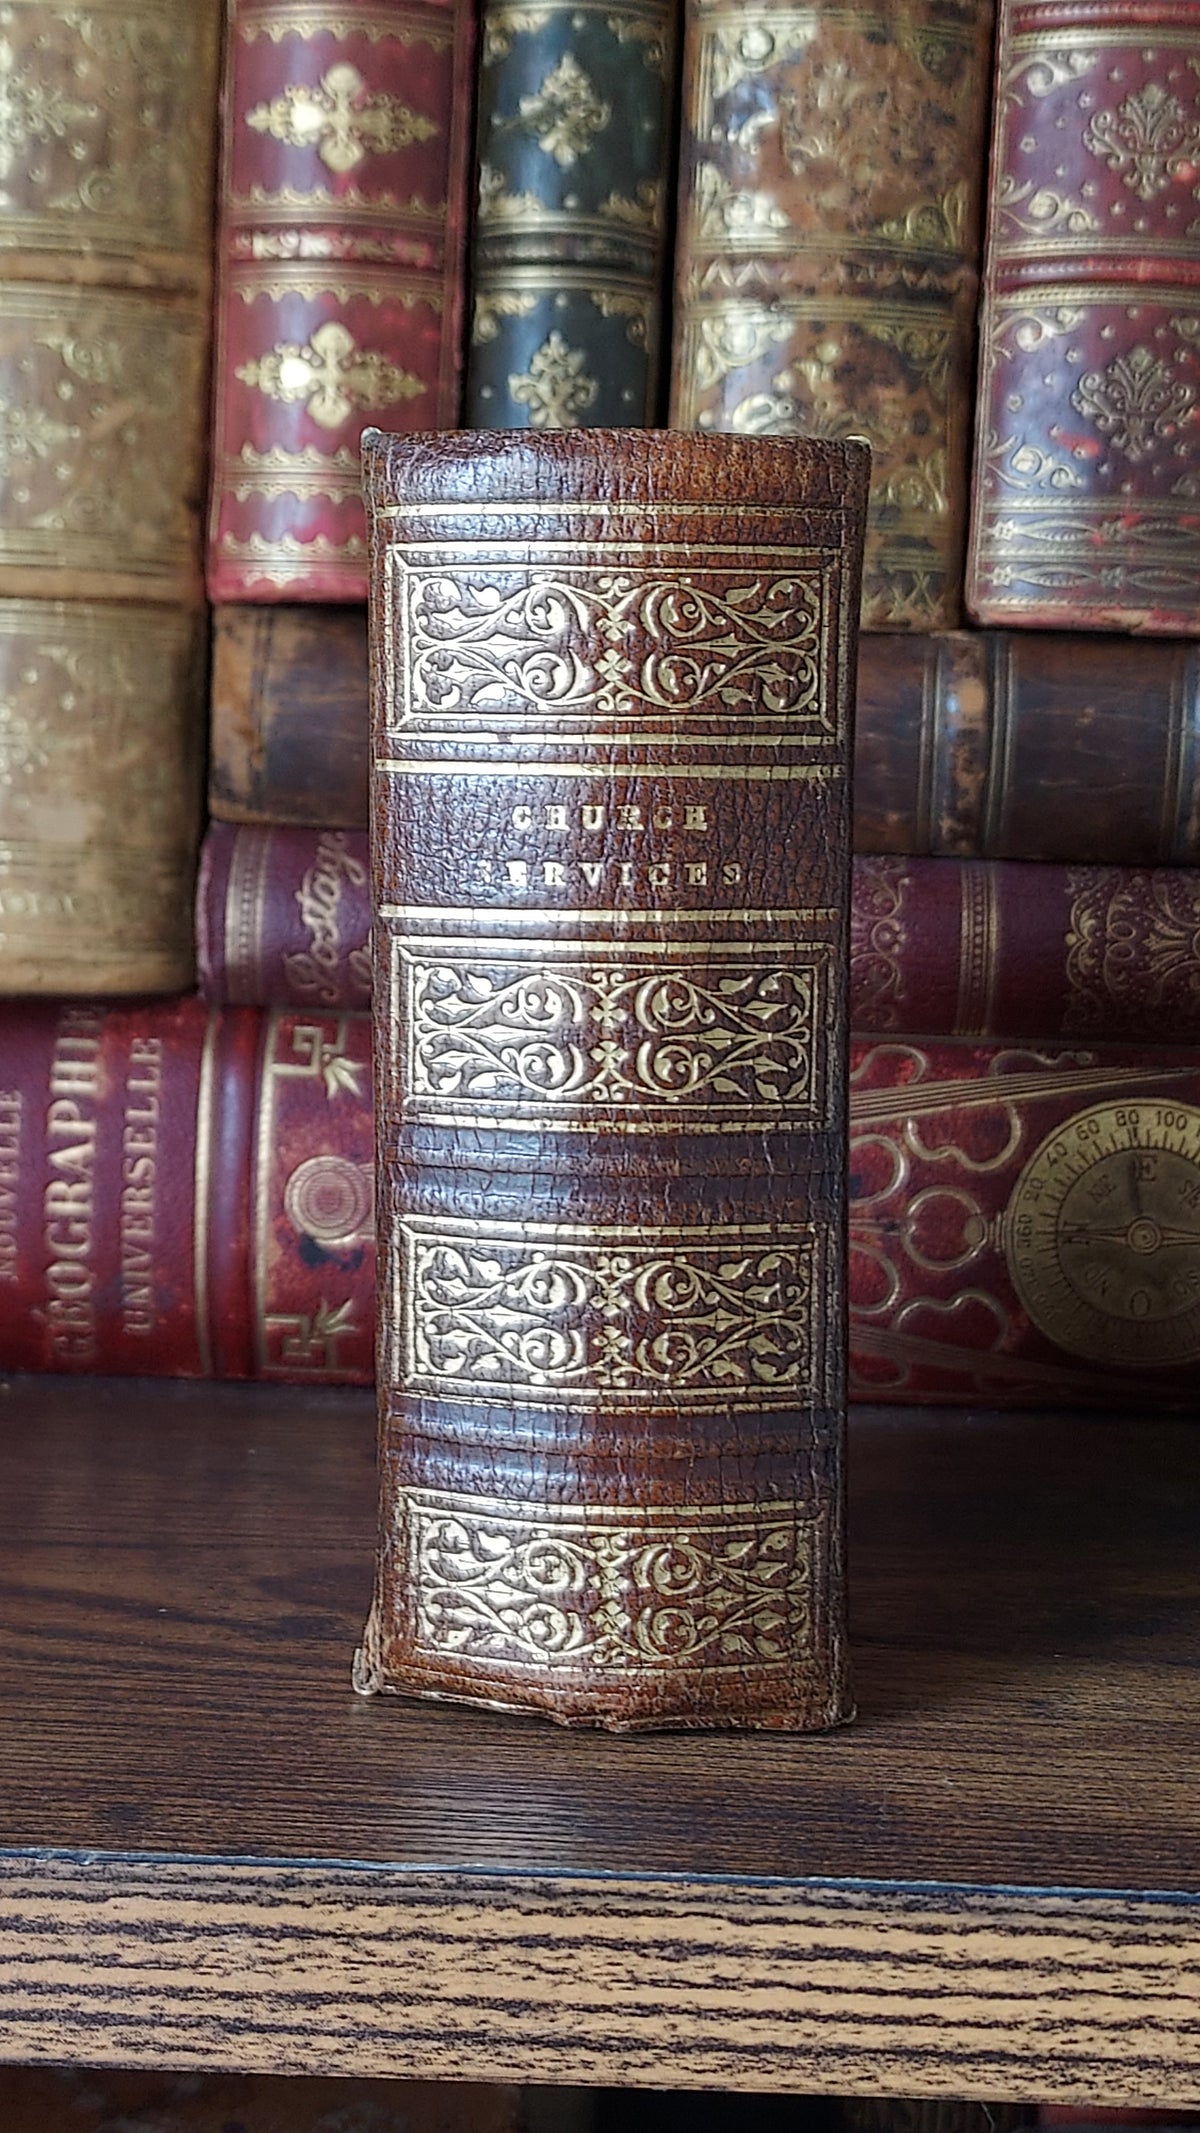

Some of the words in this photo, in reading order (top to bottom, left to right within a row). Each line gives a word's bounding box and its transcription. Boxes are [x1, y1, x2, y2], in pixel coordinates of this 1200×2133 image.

[510, 804, 709, 831] CHURCH
[477, 859, 744, 888] SERVICES
[1075, 1119, 1100, 1141] 60
[1115, 1110, 1140, 1126] 80
[1155, 1110, 1188, 1131] 100
[1047, 1142, 1068, 1167] 40
[120, 1037, 162, 1335] UNIVERSELLE
[1023, 1177, 1048, 1202] 20
[1016, 1213, 1033, 1248] 360
